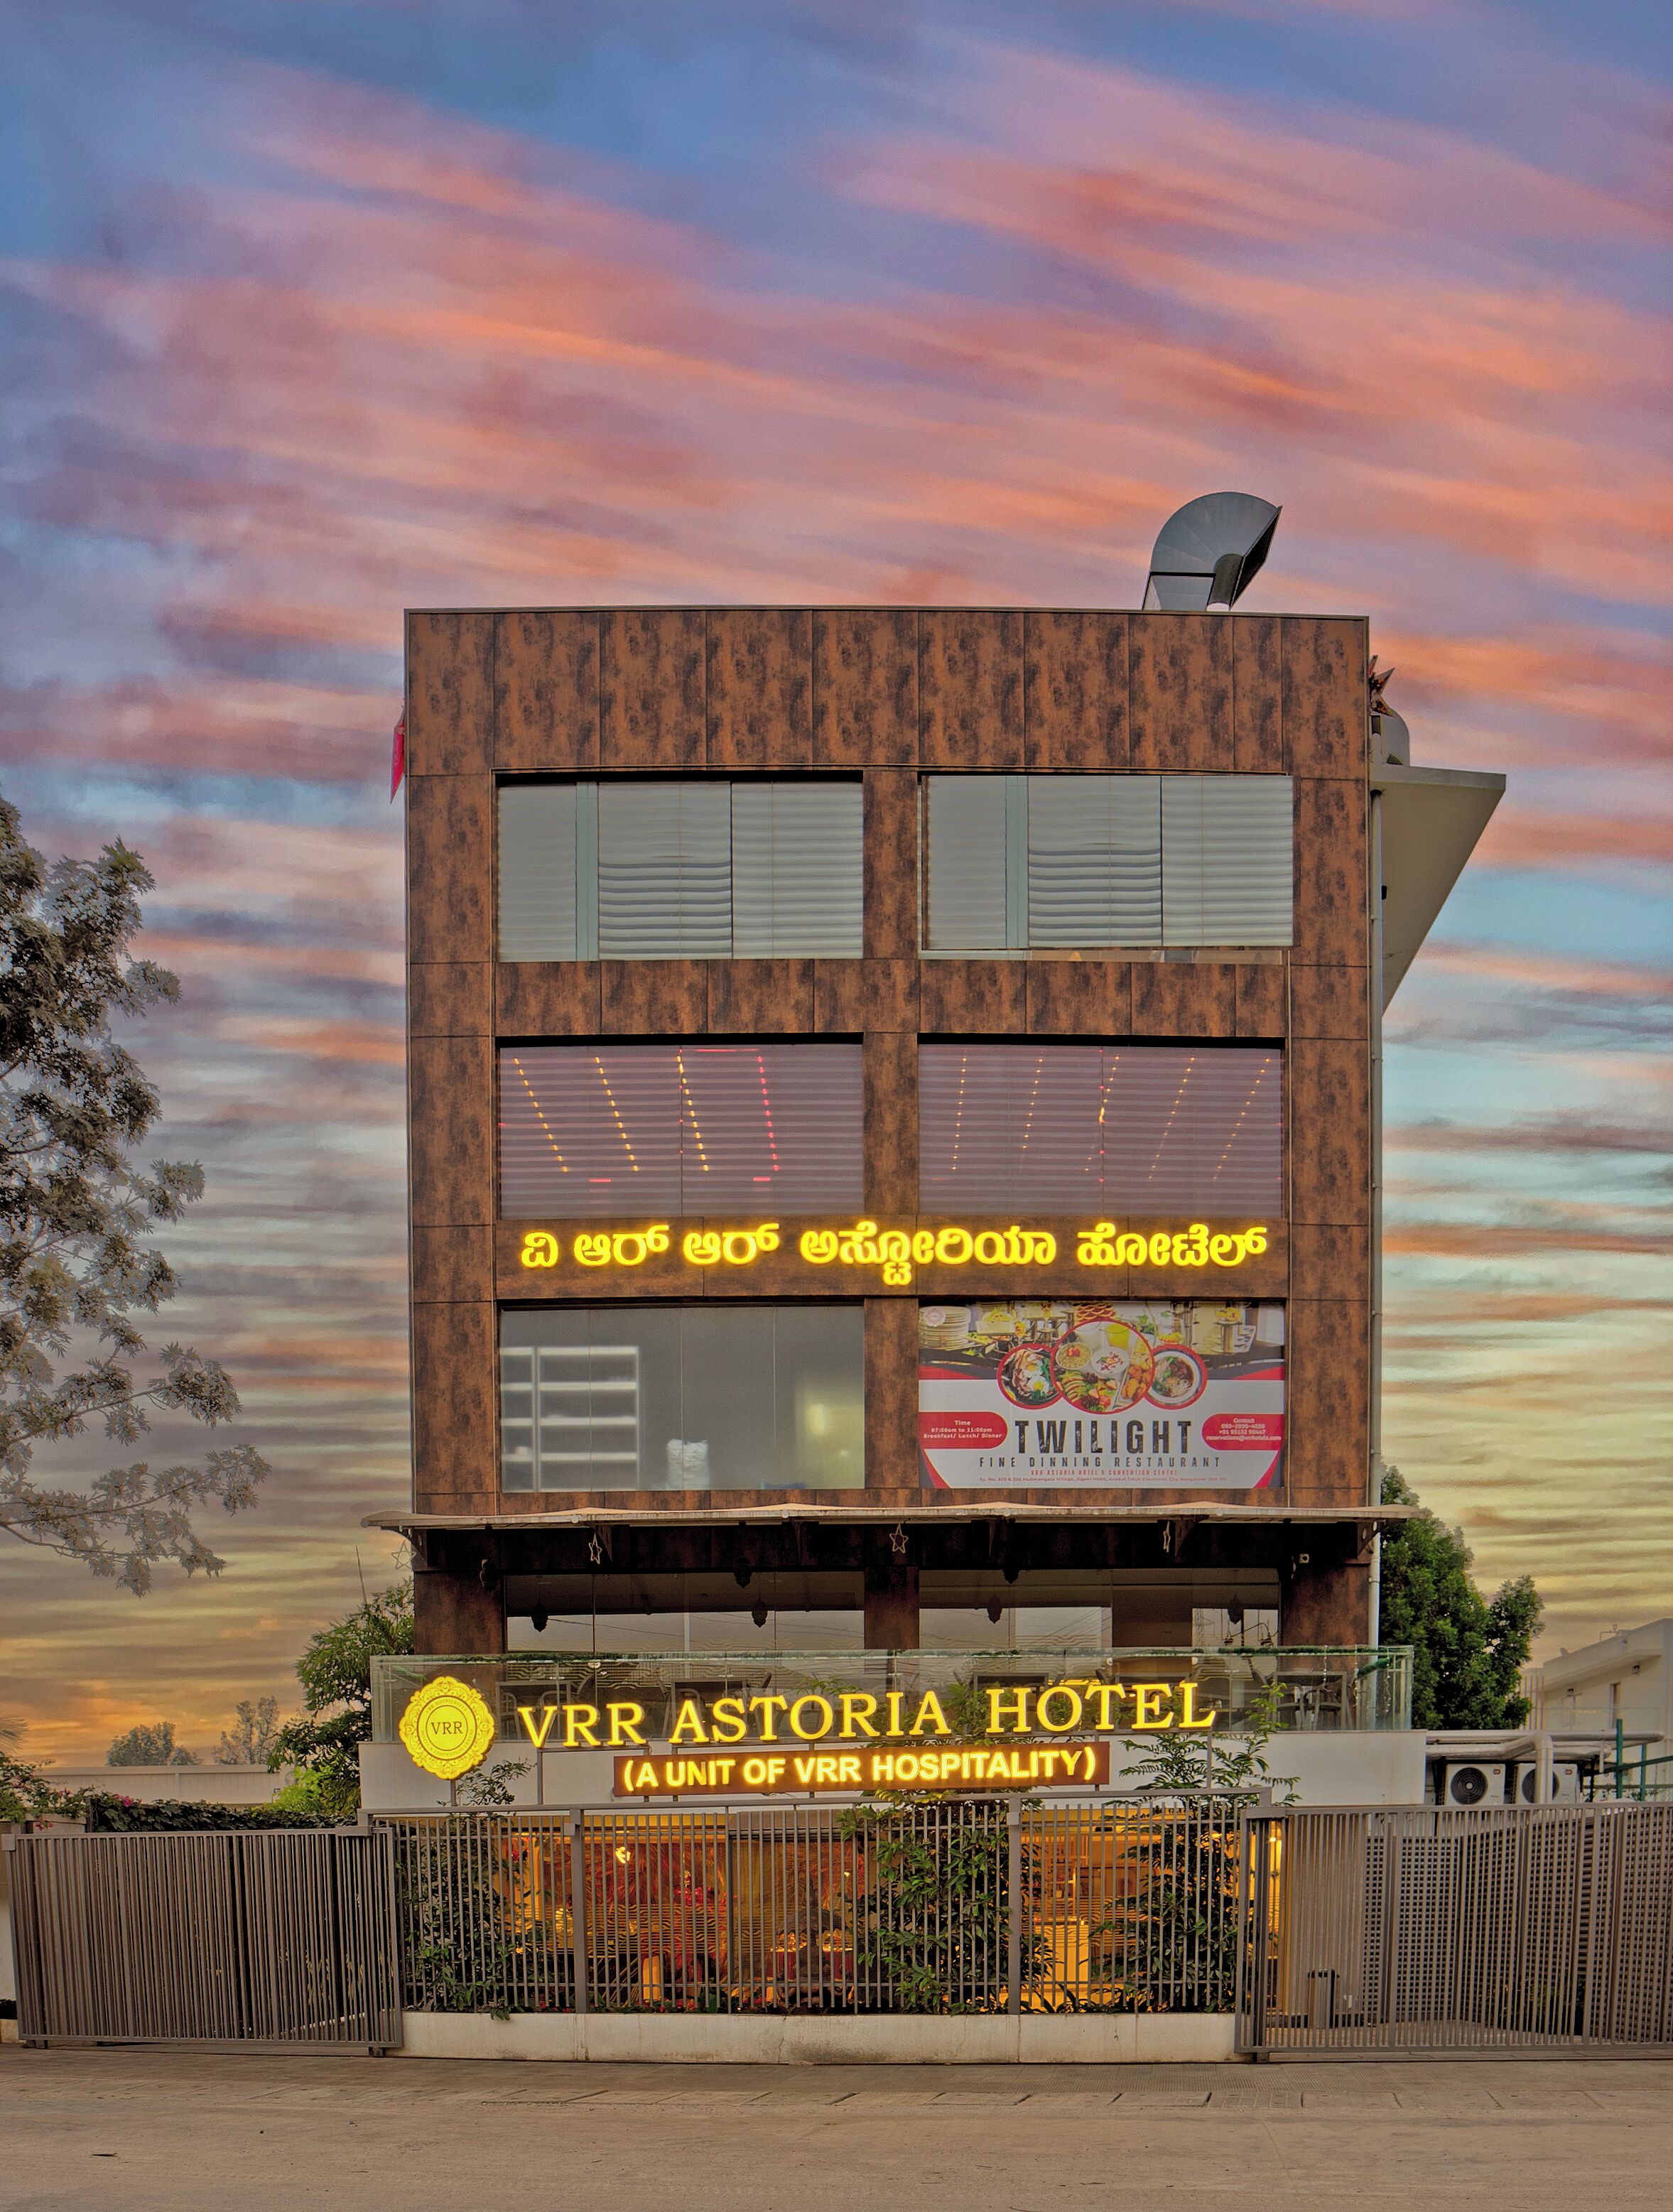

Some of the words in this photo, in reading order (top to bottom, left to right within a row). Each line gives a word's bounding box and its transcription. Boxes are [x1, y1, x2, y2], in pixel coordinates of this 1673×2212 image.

[520, 1231, 560, 1269] ವಿ
[573, 1223, 671, 1267] ಆರ್
[682, 1222, 781, 1267] ಆರ್
[798, 1220, 1057, 1286] ಅಸ್ಟೋರಿಯಾ
[1076, 1222, 1268, 1267] ಹೋಟೆಲ್
[1014, 1420, 1191, 1454] TWILIGHT
[980, 1457, 1015, 1468] FINE
[1029, 1456, 1100, 1468] DINNING
[1114, 1457, 1220, 1468] RESTAURANT
[431, 1721, 463, 1735] VRR
[517, 1703, 648, 1748] VRR
[668, 1691, 953, 1744] ASTORIA
[985, 1681, 1216, 1733] HOTEL
[623, 1760, 659, 1791] (A
[665, 1759, 737, 1787] UNIT
[742, 1757, 786, 1785] OF
[792, 1755, 862, 1784] VRR
[871, 1747, 1097, 1782] HOSPITALITY)
